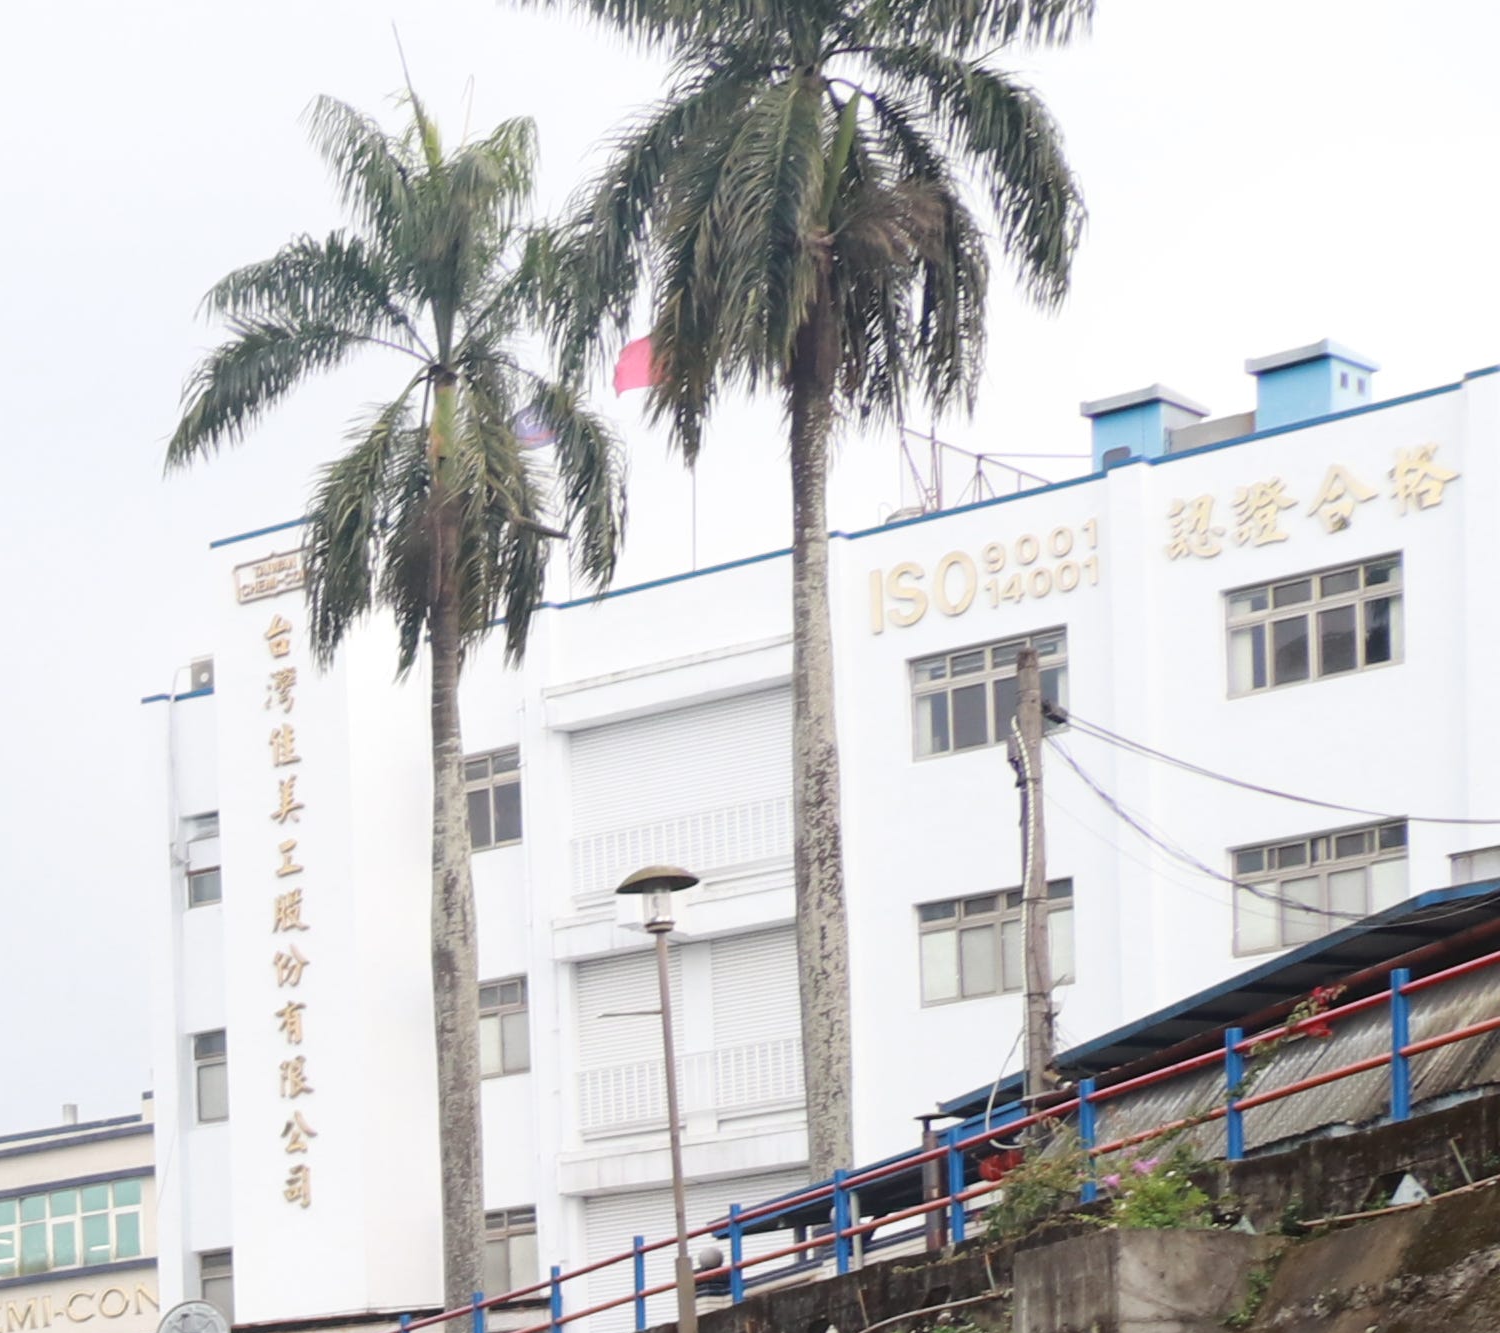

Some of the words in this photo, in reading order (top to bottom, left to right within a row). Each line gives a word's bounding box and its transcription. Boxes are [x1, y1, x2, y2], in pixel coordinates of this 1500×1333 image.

[1165, 443, 1461, 560] 認證合格
[869, 550, 977, 636] ISO
[983, 517, 1098, 574] 9001
[985, 555, 1099, 609] 14001
[264, 614, 317, 1210] 台灣佳美工股份有限公司
